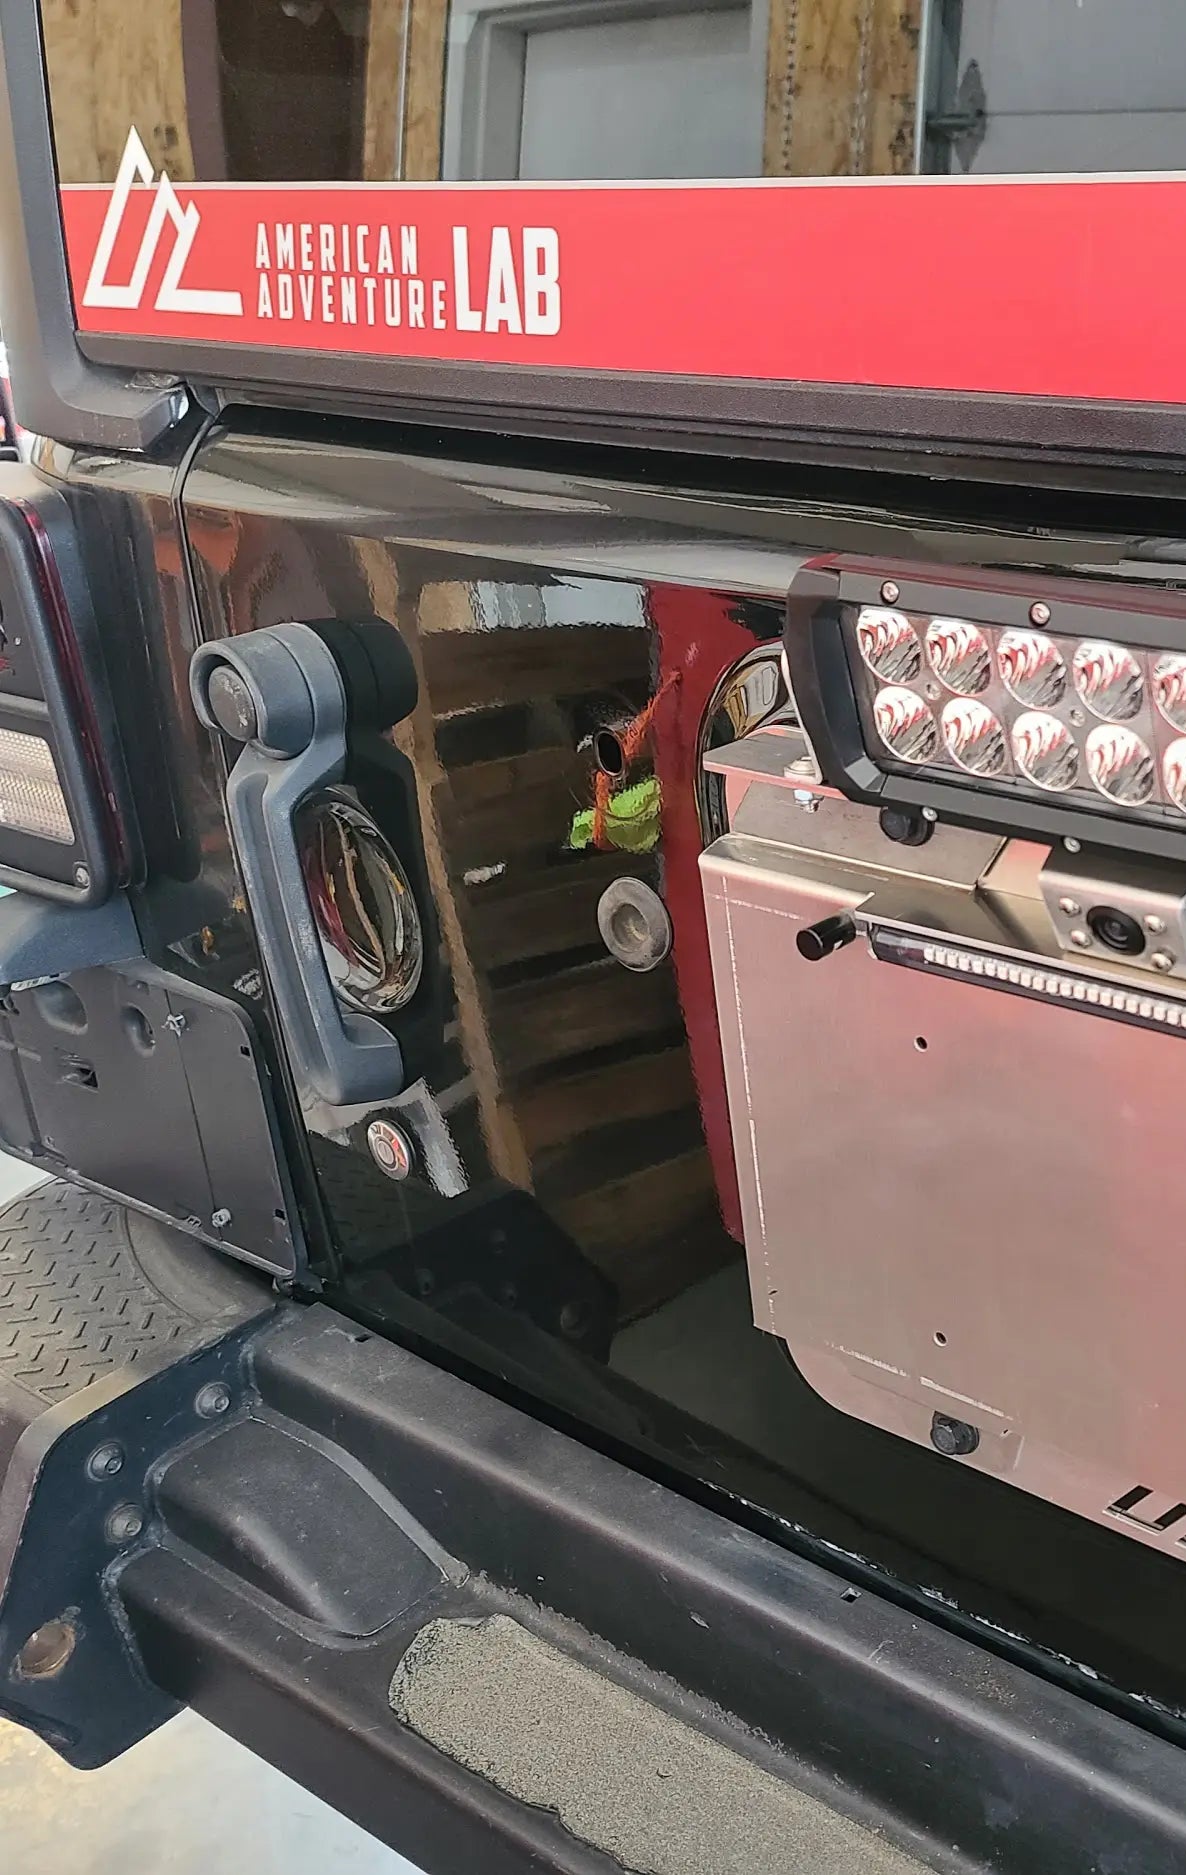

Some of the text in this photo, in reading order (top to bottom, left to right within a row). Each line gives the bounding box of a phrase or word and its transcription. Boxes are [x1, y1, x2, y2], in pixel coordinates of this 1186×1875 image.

[255, 222, 418, 275] AMERICAN
[257, 226, 562, 336] ADVENTURE LAB
